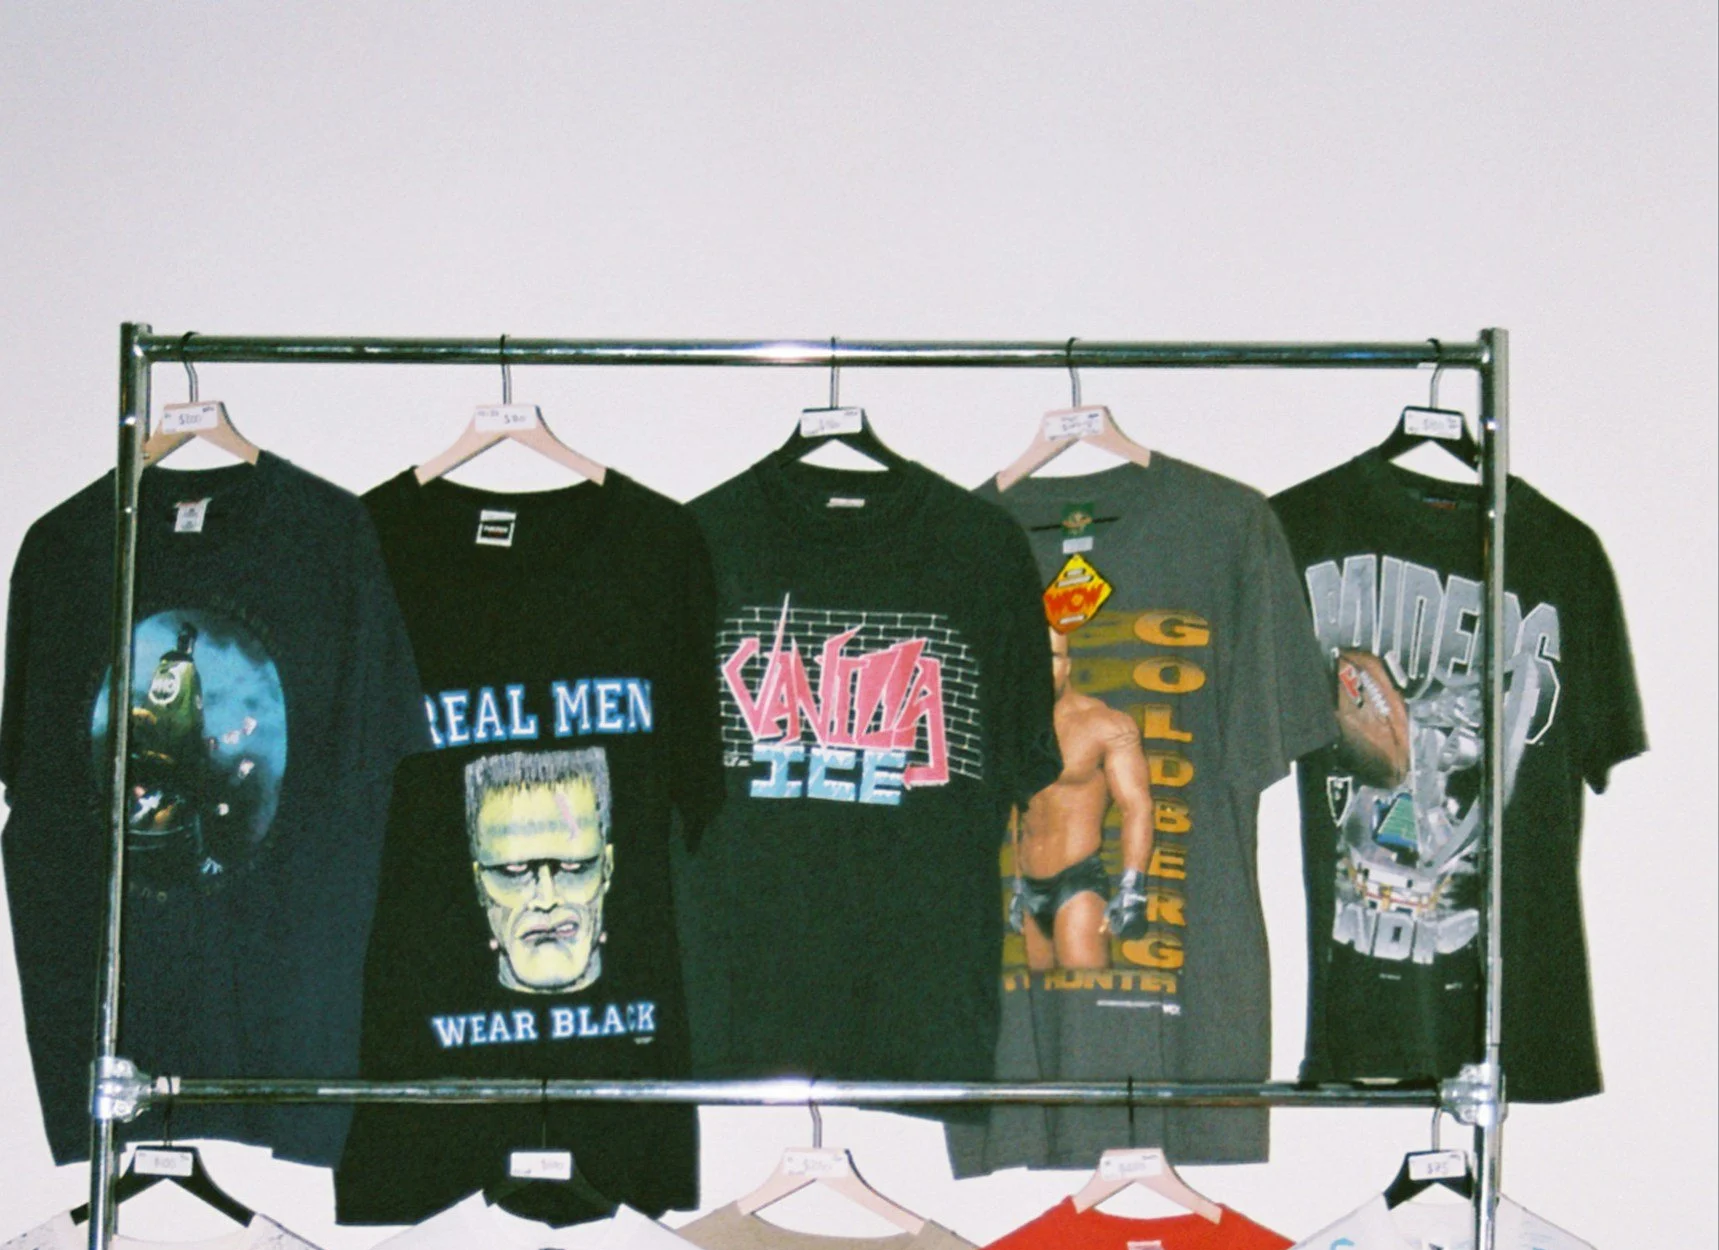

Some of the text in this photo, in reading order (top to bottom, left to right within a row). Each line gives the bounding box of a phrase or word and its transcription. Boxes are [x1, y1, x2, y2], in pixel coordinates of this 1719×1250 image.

[552, 677, 655, 738] MEN
[750, 745, 907, 806] ICE
[1122, 610, 1210, 970] GOLDBERG
[432, 1010, 540, 1048] WEAR
